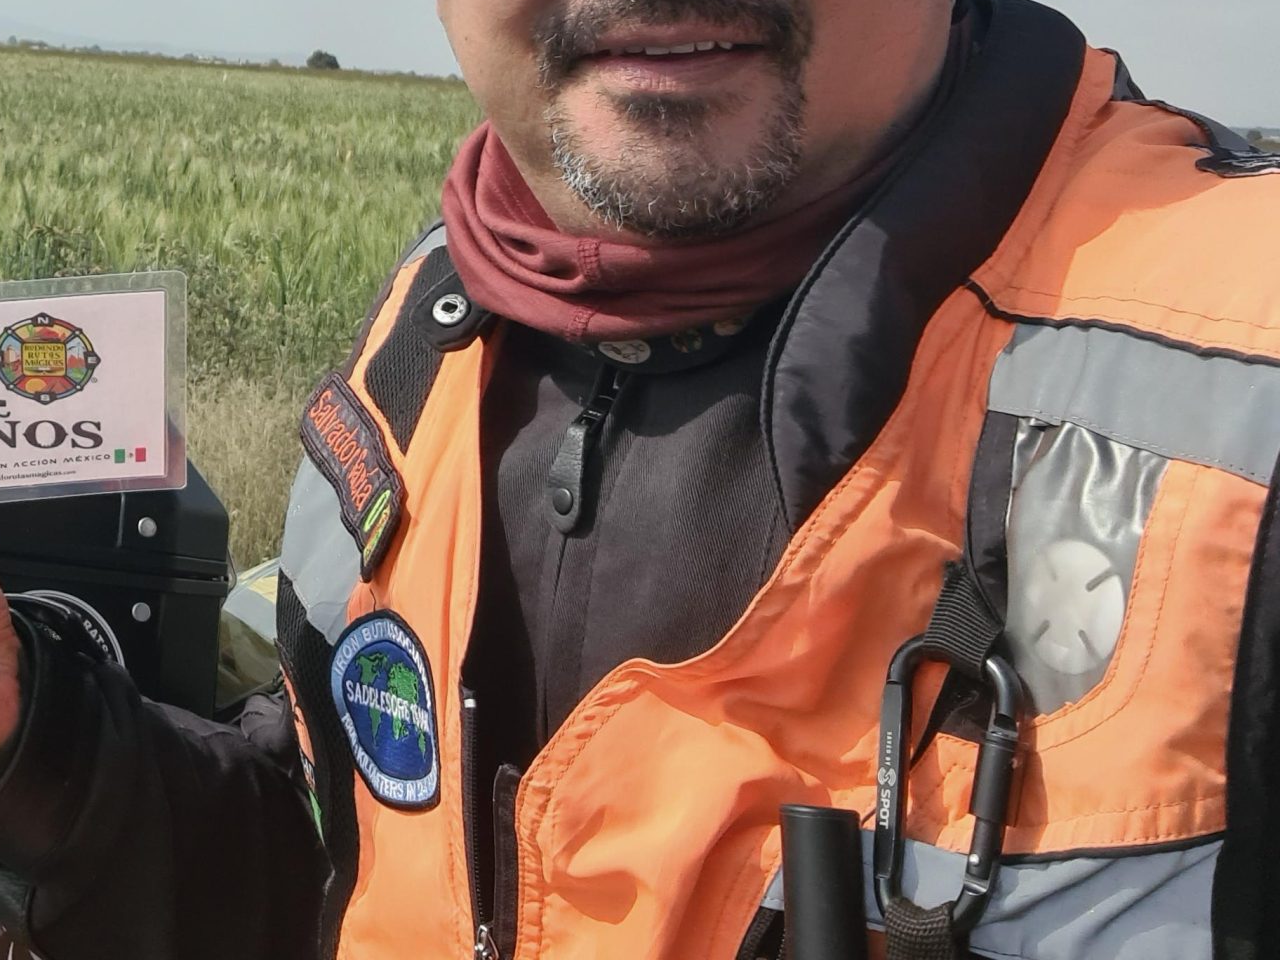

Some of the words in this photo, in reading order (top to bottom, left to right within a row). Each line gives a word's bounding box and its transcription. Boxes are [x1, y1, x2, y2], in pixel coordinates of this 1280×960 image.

[309, 390, 365, 470] Salvador
[335, 634, 359, 677] IRON
[346, 680, 411, 722] SADDLESORE
[879, 789, 891, 830] SPOT
